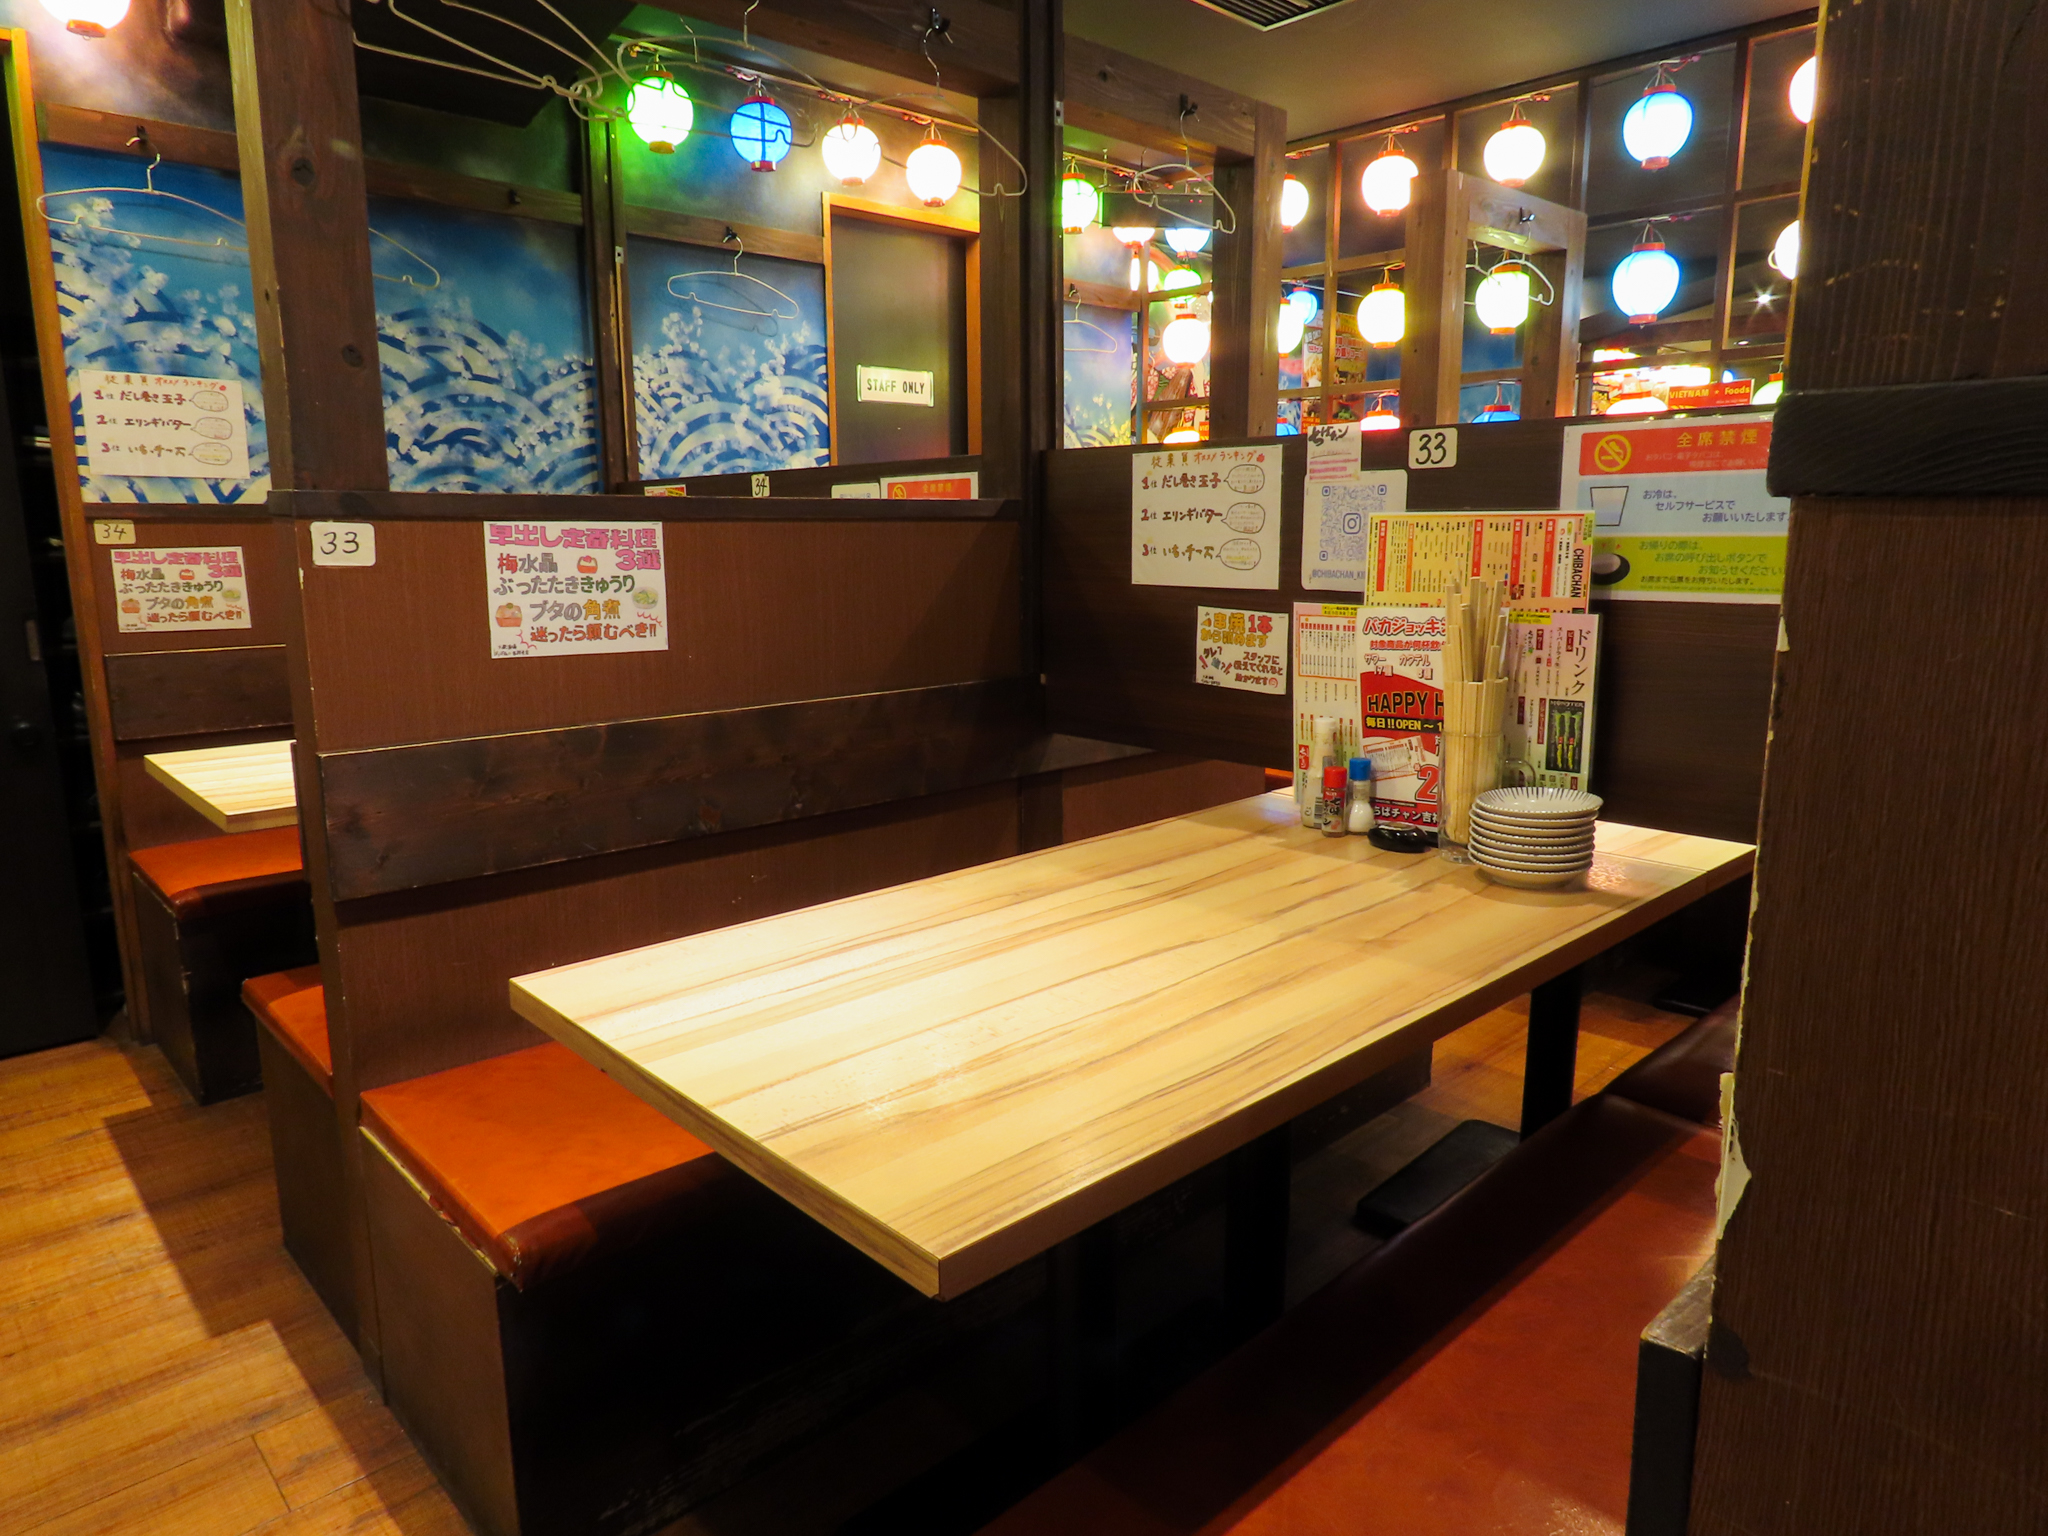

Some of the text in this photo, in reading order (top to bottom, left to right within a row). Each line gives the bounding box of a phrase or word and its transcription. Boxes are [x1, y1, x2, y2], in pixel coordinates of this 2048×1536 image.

[866, 378, 926, 394] STAFF ONLY
[1669, 384, 1750, 399] VIETNAM Foods
[1676, 428, 1758, 448] 全席禁煙
[1415, 432, 1447, 466] 33
[754, 478, 768, 495] 34
[1656, 500, 1736, 512] セルフサービスで
[1162, 507, 1224, 524] エリンギバター
[102, 524, 126, 540] 34
[489, 524, 657, 550] 早出し定番料理
[320, 530, 360, 555] 33
[114, 550, 239, 566] 早出し定番料理
[497, 552, 558, 575] 梅水晶
[616, 549, 661, 572] 3選
[120, 568, 166, 580] 梅水晶
[1570, 548, 1584, 598] CHIBACHAN
[118, 580, 224, 594] ぶったたききゅうり
[494, 574, 636, 596] ぶったたききゅうり
[145, 595, 214, 610] ブタの角煮
[530, 598, 622, 622] ブタの角煮
[1399, 654, 1432, 666] カクテル
[1571, 628, 1592, 696] ドリンク
[1366, 692, 1429, 715] HAPPY
